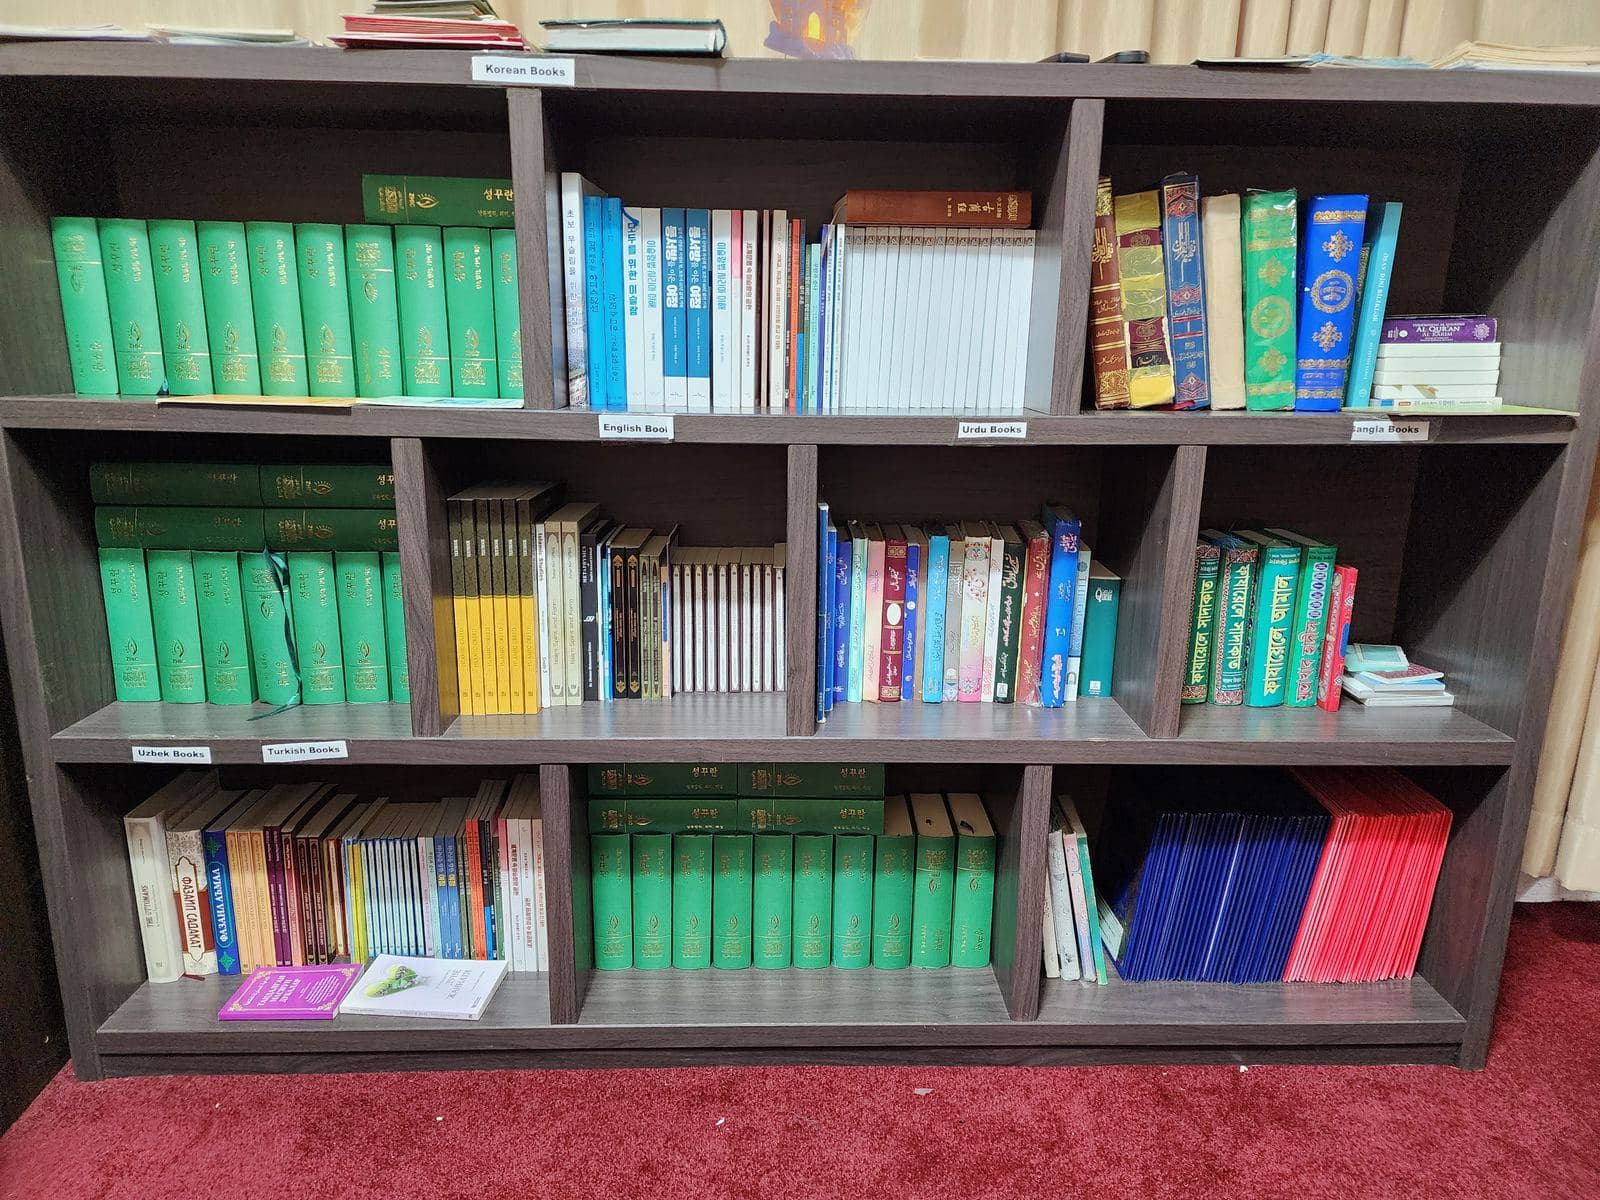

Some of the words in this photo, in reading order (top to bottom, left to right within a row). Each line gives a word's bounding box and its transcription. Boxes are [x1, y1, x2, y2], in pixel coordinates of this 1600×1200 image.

[485, 64, 526, 76] Korean
[530, 66, 566, 78] Books
[628, 258, 638, 281] 위한
[628, 284, 638, 316] 이슬람
[603, 422, 642, 434] English
[962, 424, 994, 434] Urdu
[996, 425, 1022, 434] Books
[1388, 424, 1420, 434] Books
[1196, 580, 1214, 630] সাদাকাত
[1270, 575, 1294, 624] আমাল
[1226, 621, 1244, 670] সাদাকাত
[1263, 627, 1288, 696] ফাযায়েলে
[138, 750, 170, 758] Uzbek
[173, 750, 205, 759] Books
[267, 747, 306, 756] Turkish
[309, 746, 340, 755] Books
[692, 766, 718, 778] 성꾸란
[840, 766, 866, 778] 성꾸란
[692, 807, 718, 818] 성꾸란
[840, 808, 865, 820] 성꾸란
[186, 913, 201, 948] САДАКАТ
